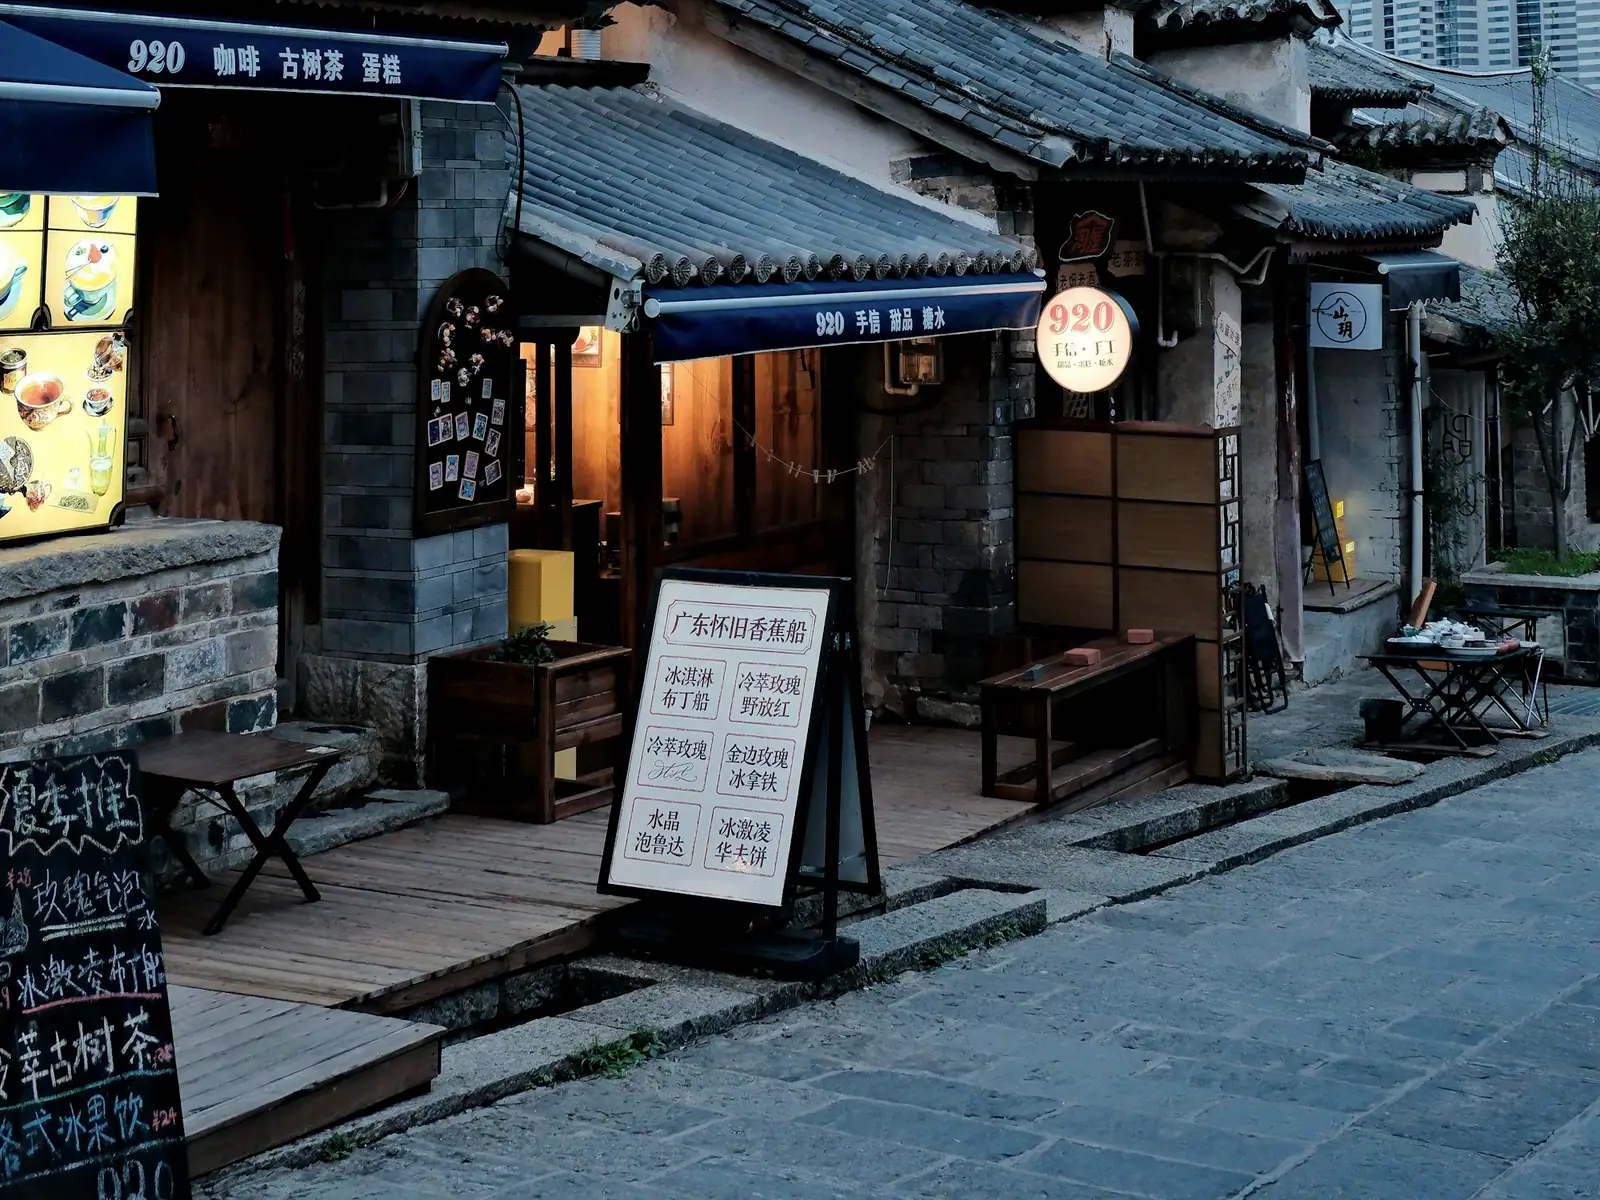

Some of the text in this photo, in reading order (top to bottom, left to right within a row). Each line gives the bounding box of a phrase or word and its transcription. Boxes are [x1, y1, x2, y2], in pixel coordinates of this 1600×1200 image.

[127, 39, 403, 85] 920 咖啡 古树茶 蛋糕
[815, 305, 946, 337] 920 手信 甜品 糖水
[1049, 301, 1115, 335] 920
[670, 611, 808, 645] 广东怀旧香蕉船
[664, 665, 715, 687] 冰淇淋
[737, 672, 801, 697] 冷萃玫瑰
[661, 689, 711, 712] 布丁船
[740, 697, 791, 719] 野放红
[646, 736, 708, 762] 冷萃玫瑰
[725, 743, 789, 770] 金边玫瑰
[728, 768, 778, 793] 冰拿铁
[12, 769, 140, 836] 夏季推
[647, 808, 681, 832] 水晶
[719, 817, 773, 843] 冰激凌
[635, 831, 687, 858] 泡鲁达
[714, 841, 768, 868] 华夫饼
